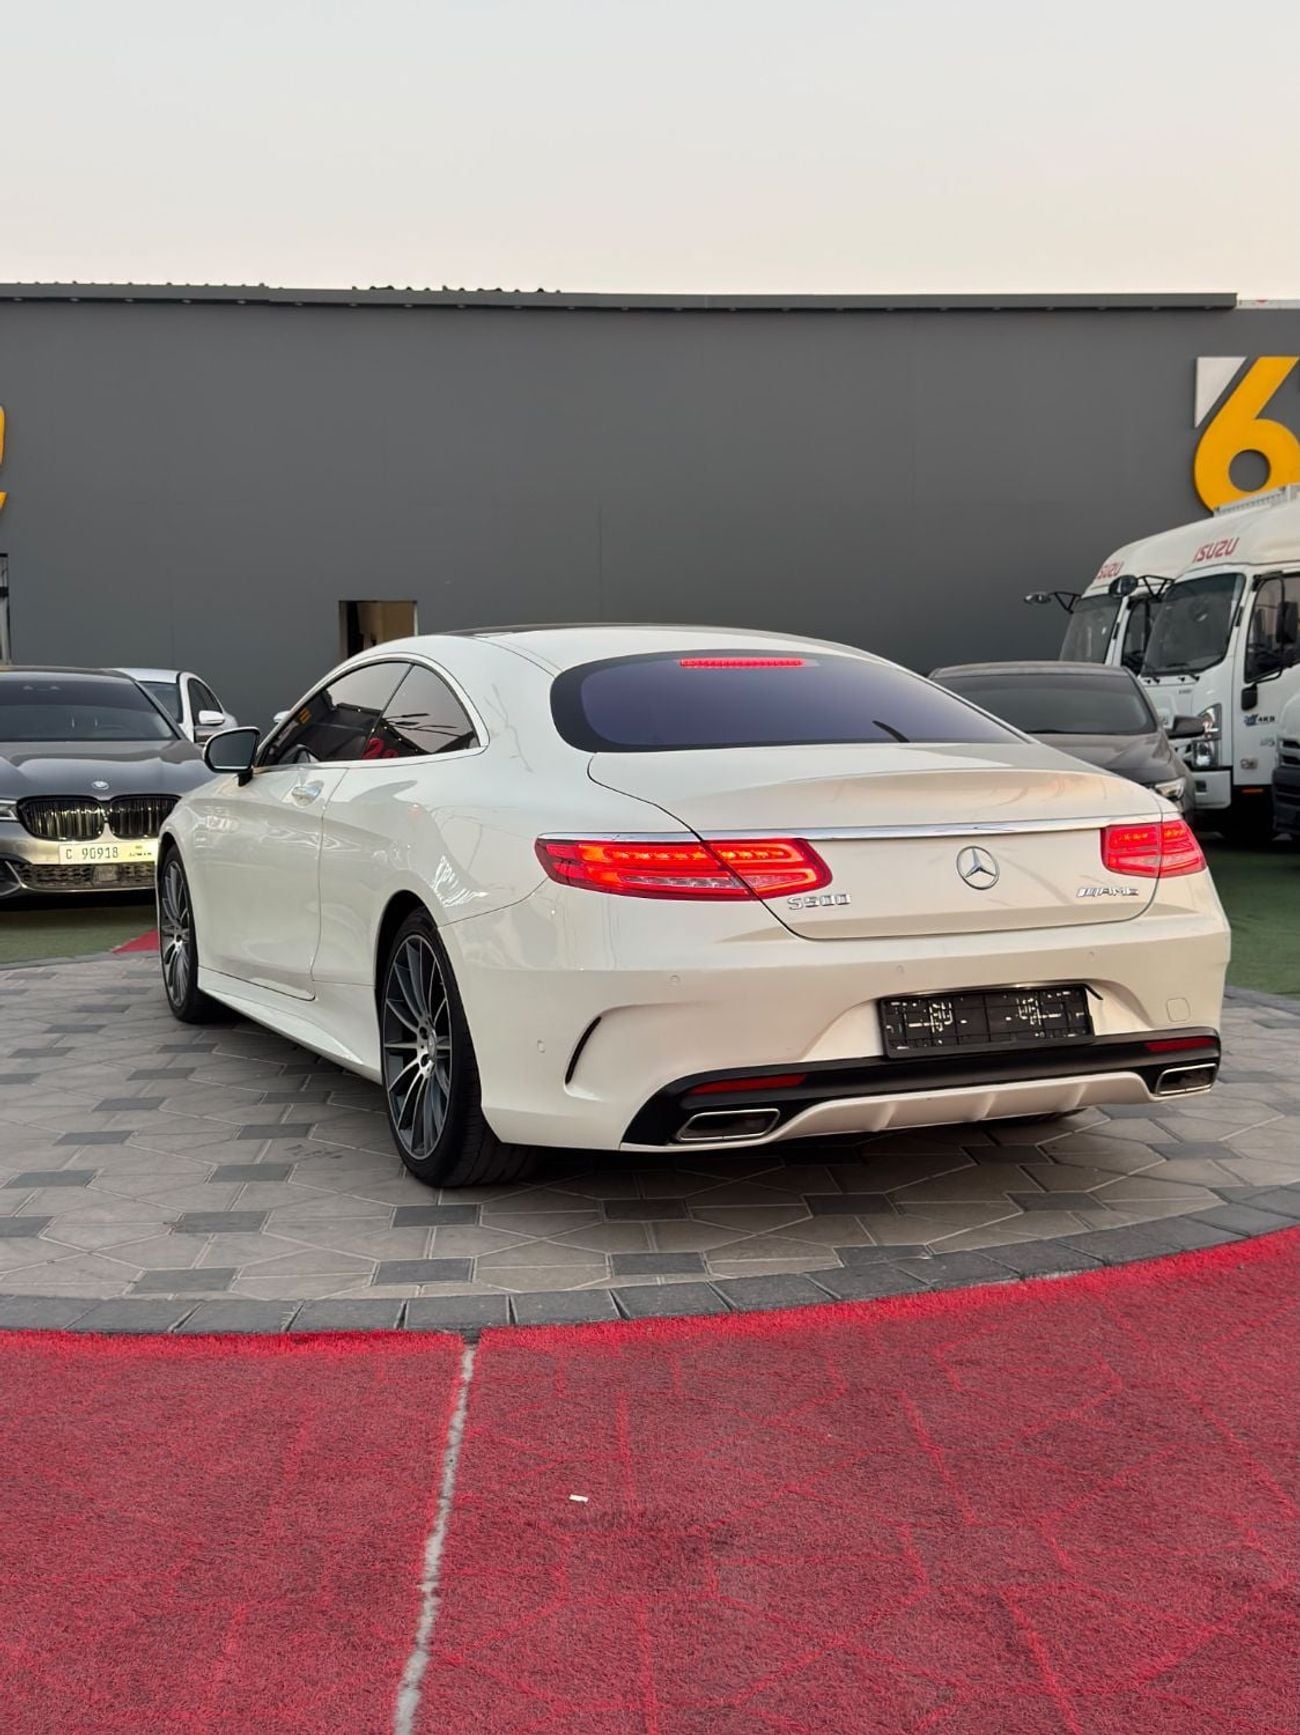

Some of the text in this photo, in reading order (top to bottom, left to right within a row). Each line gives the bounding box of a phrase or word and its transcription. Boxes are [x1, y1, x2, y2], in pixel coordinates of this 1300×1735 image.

[1192, 537, 1240, 563] ISUZU
[1097, 561, 1125, 580] SUZU
[65, 848, 73, 860] C
[81, 846, 119, 860] 90918
[787, 893, 852, 910] S500
